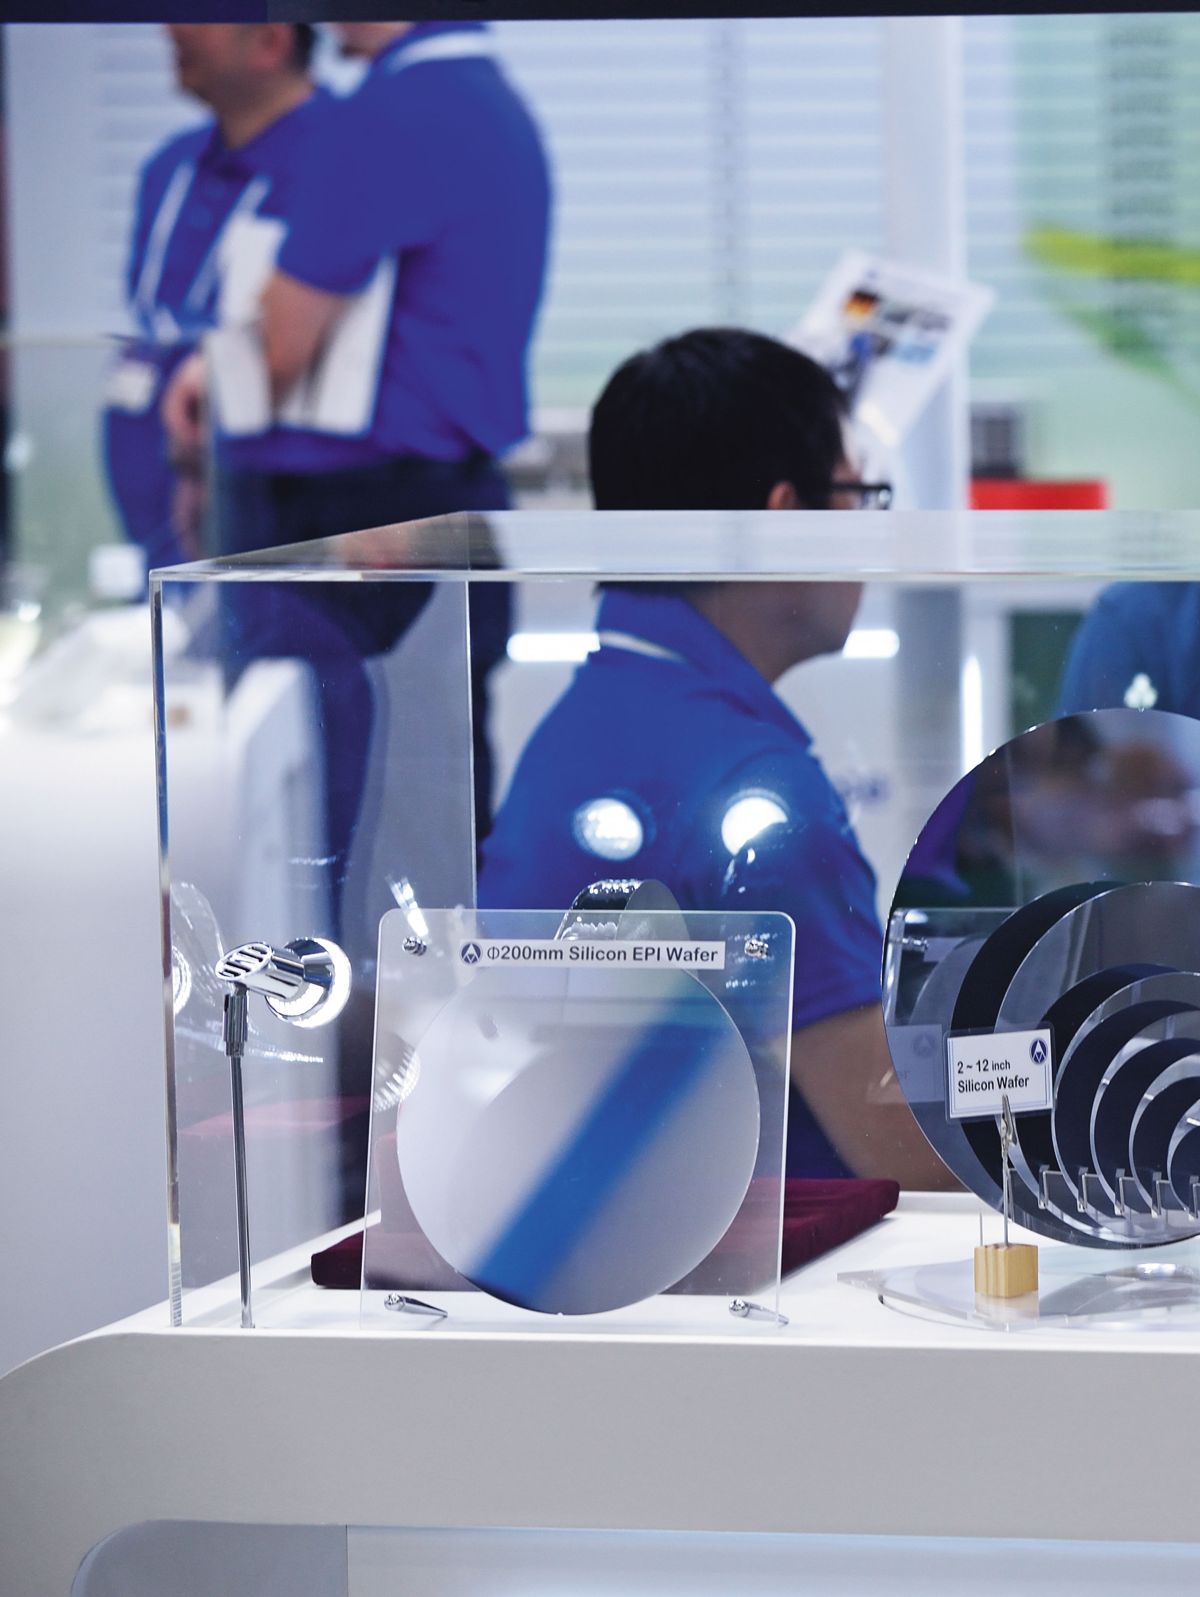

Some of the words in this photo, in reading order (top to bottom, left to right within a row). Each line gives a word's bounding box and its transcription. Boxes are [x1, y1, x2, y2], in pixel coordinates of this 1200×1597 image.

[569, 946, 627, 961] Silicon
[633, 947, 661, 961] EPI
[665, 947, 719, 963] Wafer
[991, 1060, 1011, 1071] inch
[958, 1079, 994, 1093] Silicon
[997, 1075, 1029, 1089] Wafer
